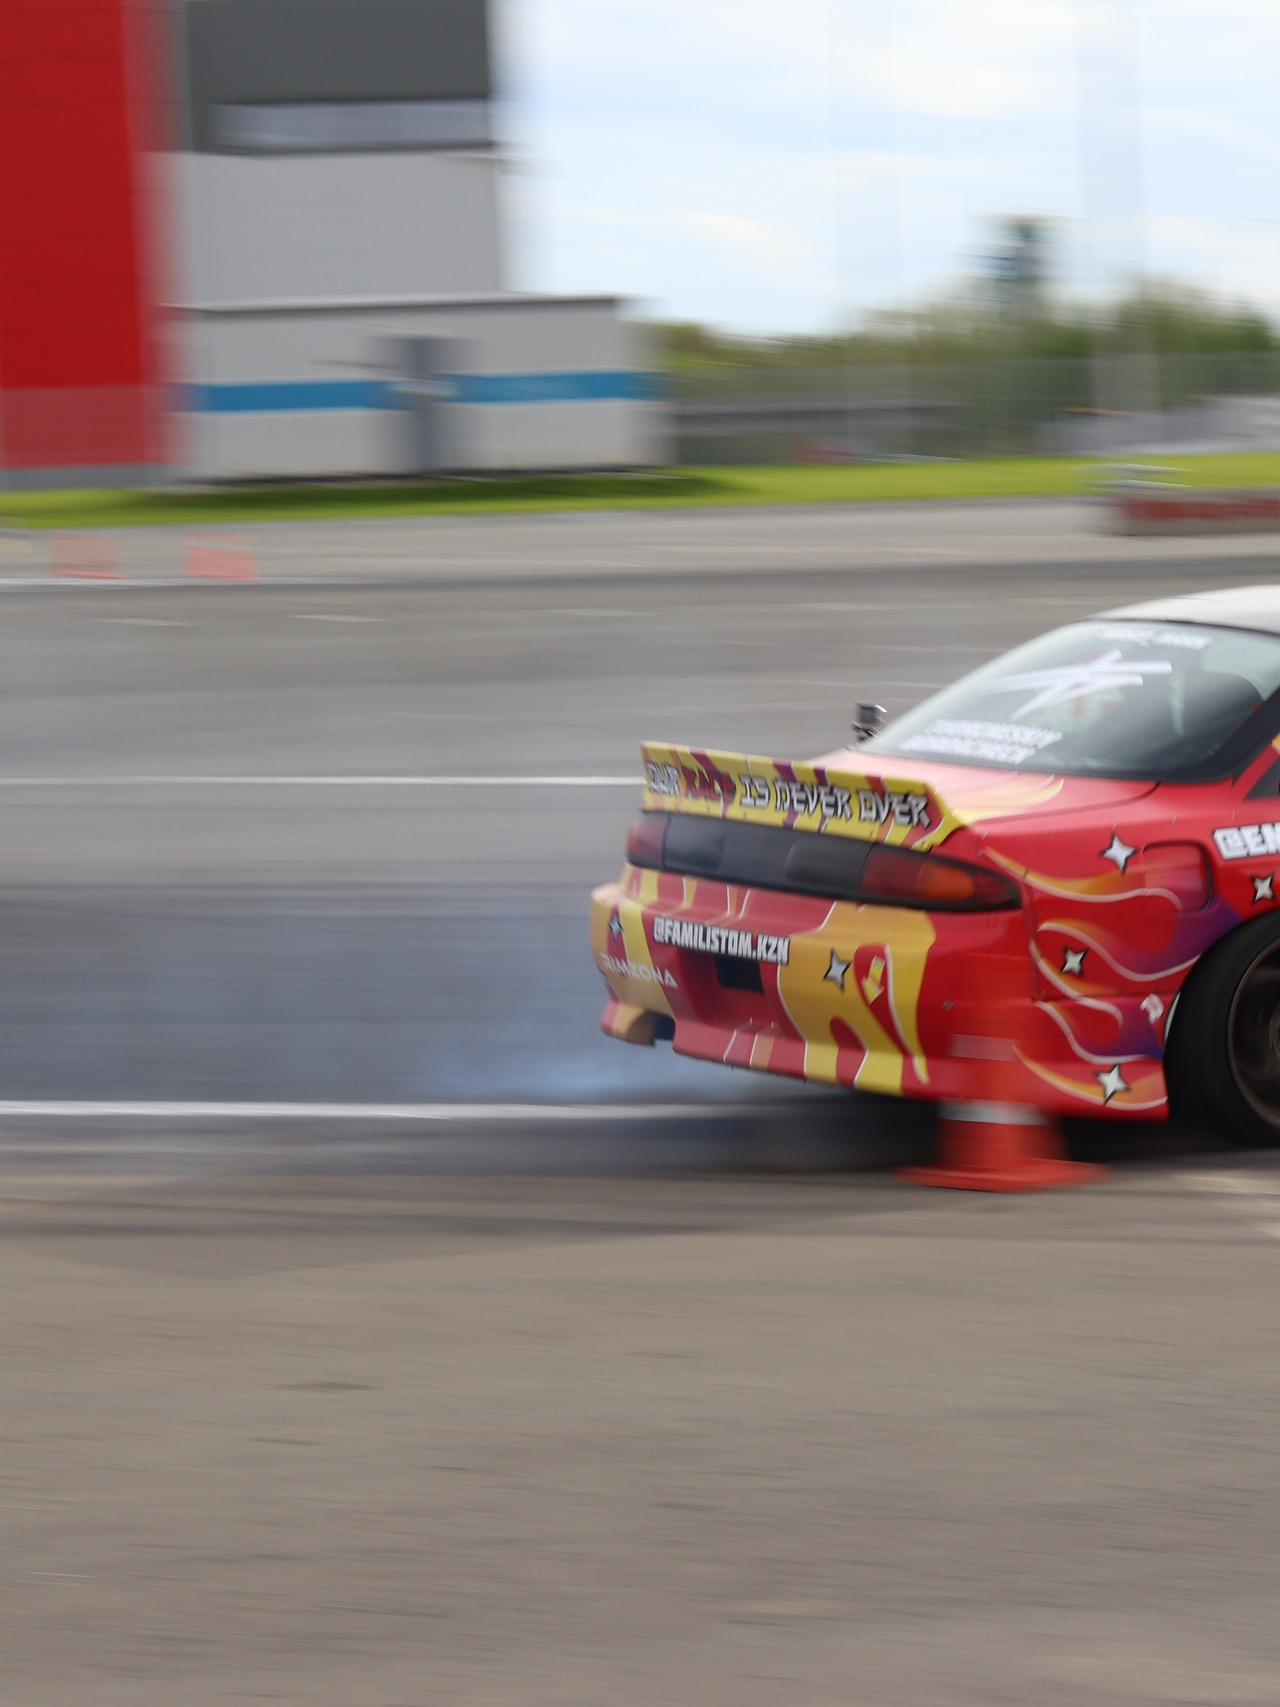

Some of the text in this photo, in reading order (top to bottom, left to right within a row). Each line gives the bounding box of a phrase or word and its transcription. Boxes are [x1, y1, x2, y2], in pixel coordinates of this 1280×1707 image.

[739, 775, 769, 809] IS
[774, 779, 852, 819] NEVER
[858, 789, 931, 828] OVER
[653, 916, 790, 965] @FAMILISTOM.KZN
[600, 953, 678, 989] RIMZONA
